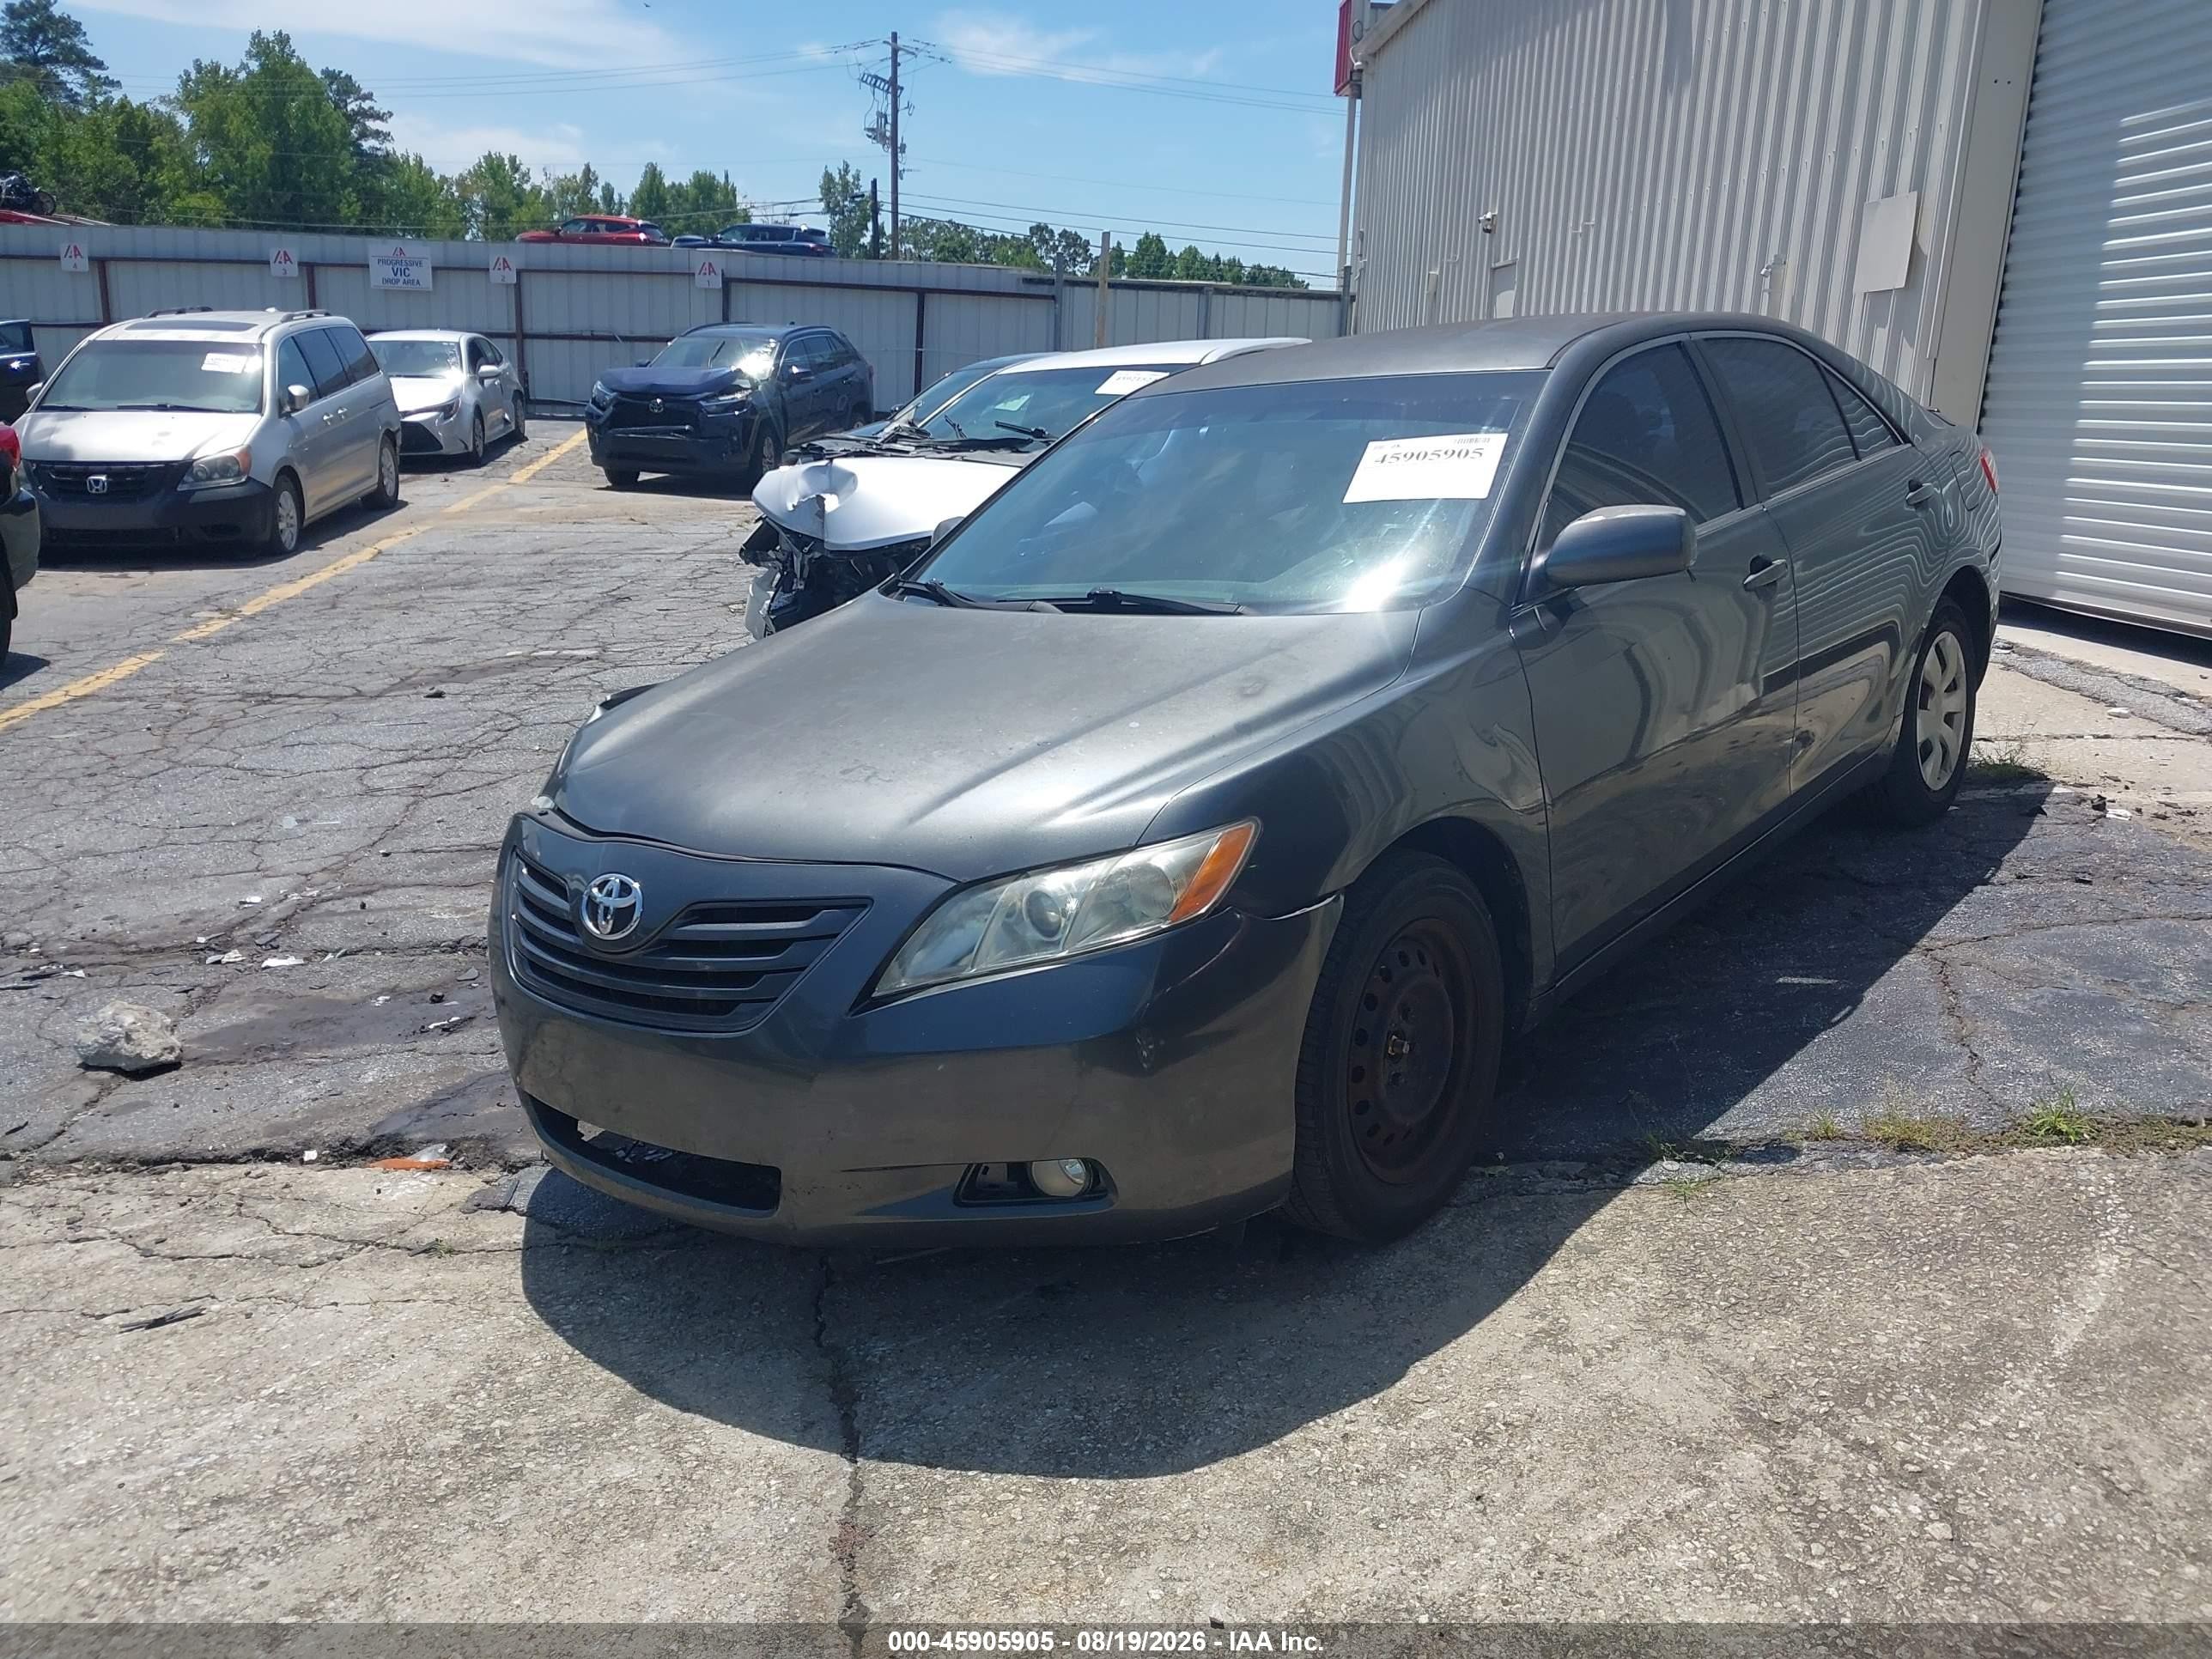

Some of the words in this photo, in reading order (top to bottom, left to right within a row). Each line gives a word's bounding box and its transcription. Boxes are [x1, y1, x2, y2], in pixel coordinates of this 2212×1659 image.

[377, 258, 424, 267] PROGRESSIVE
[391, 267, 410, 277] VIC
[1375, 447, 1485, 464] 45905905
